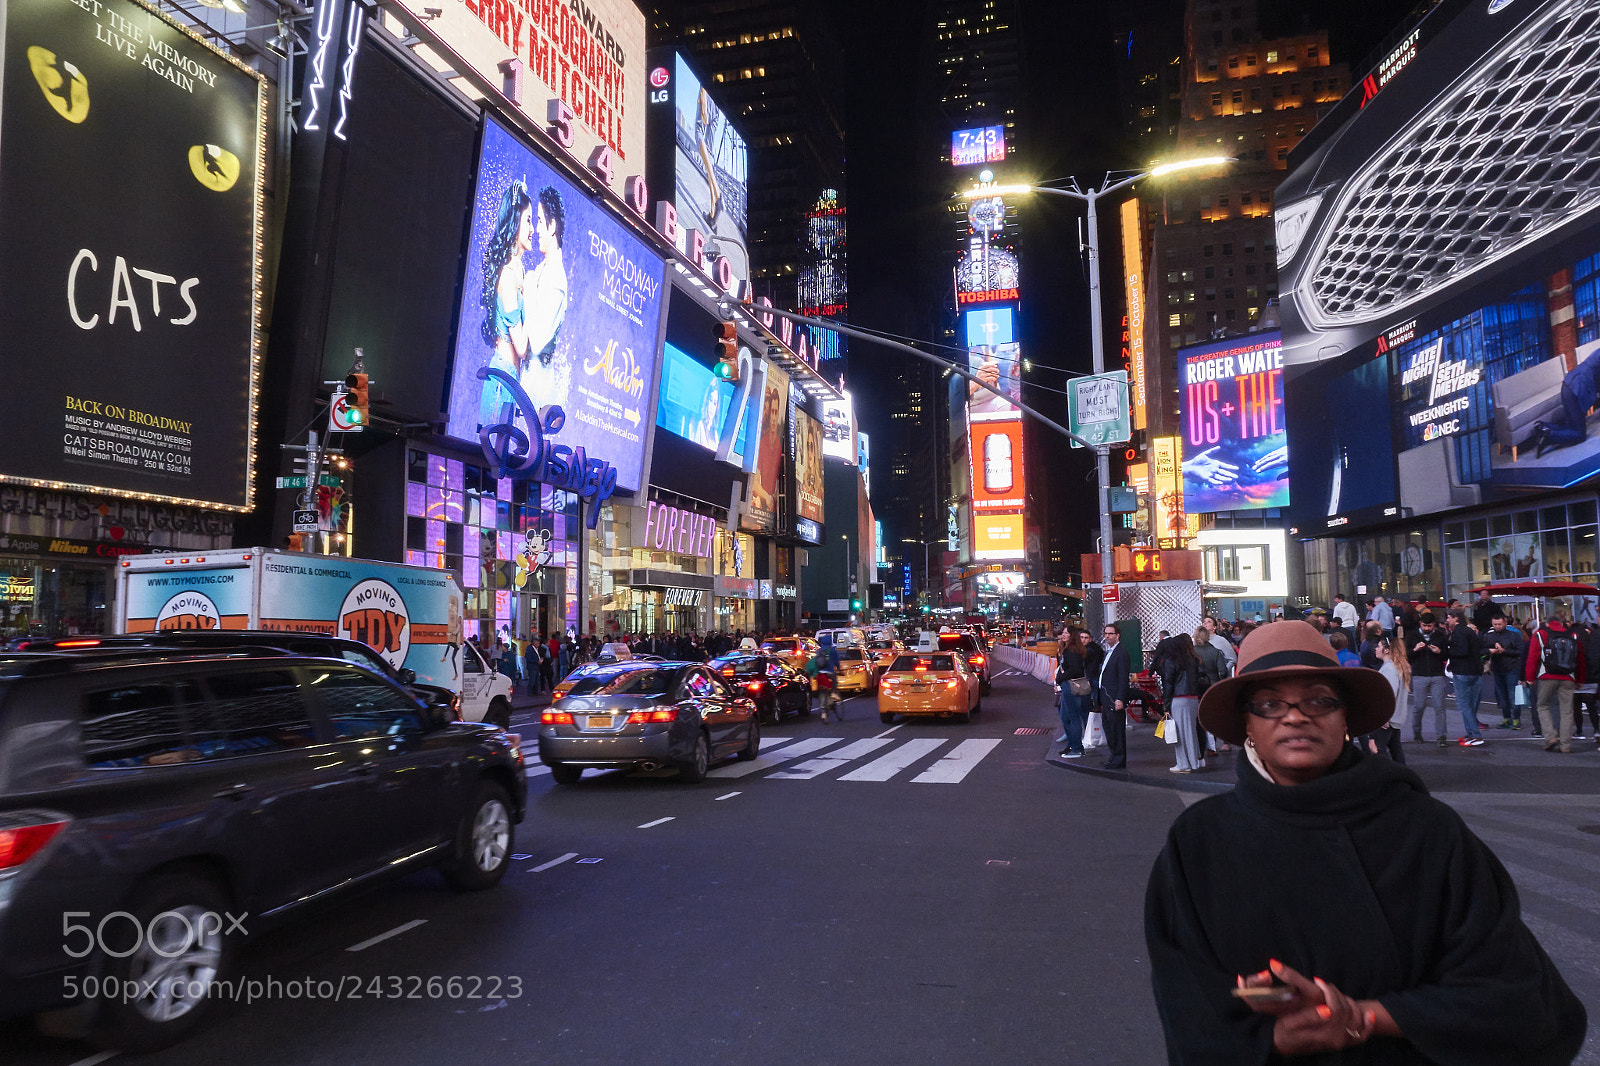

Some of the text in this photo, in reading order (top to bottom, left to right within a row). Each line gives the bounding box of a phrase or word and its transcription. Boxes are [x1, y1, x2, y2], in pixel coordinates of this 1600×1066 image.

[570, 0, 625, 68] AWARD
[96, 23, 194, 94] LIVE AGAIN
[108, 9, 143, 44] THE
[148, 34, 217, 88] MEMORY
[1379, 28, 1420, 74] MARRIOTT
[1380, 47, 1416, 87] MARQUIS
[529, 24, 626, 160] MITCHELL
[651, 89, 668, 104] LG
[959, 130, 996, 148] 7:43
[497, 58, 820, 371] 1540 BROADWAY
[68, 248, 200, 332] CATS
[1130, 274, 1138, 284] 15
[958, 288, 1018, 304] TOSHIBA
[1132, 289, 1142, 328] October
[1388, 320, 1417, 340] MARRIOTT
[1389, 330, 1414, 348] MARQUIS
[1134, 337, 1142, 350] 15
[1200, 350, 1228, 362] CREATIVE
[1230, 346, 1254, 356] GENIUS
[1254, 343, 1264, 351] OF
[1264, 340, 1282, 348] PINK
[1187, 347, 1284, 384] ROGER WATE
[1412, 344, 1437, 368] LATE
[584, 338, 644, 400] Aladdin
[1132, 351, 1146, 406] September
[1402, 360, 1434, 386] NIGHT
[1437, 359, 1467, 384] SETH
[1080, 382, 1115, 394] RIGHT LANE
[1434, 368, 1480, 398] MEYERS
[1086, 396, 1108, 406] MUST
[1188, 380, 1220, 446] US
[1235, 369, 1284, 439] THE
[1410, 396, 1470, 426] WEEKNIGHTS
[66, 396, 192, 434] BACK ON BROADWAY
[1078, 408, 1118, 420] TURN RIGHT
[65, 414, 192, 446] MUSIC BY ANDREW LLOYD WEBBER
[575, 409, 638, 442] AladdinTheMusical.com
[1090, 432, 1104, 441] 45
[1109, 430, 1120, 440] ST
[1438, 419, 1460, 436] NBC
[64, 434, 191, 466] CATSBROADWAY.COM
[72, 447, 86, 457] Neil
[88, 450, 110, 460] Simon
[112, 454, 138, 466] Theatre
[144, 460, 156, 469] 250
[166, 464, 182, 473] 52nd
[1157, 458, 1171, 466] LION
[1157, 466, 1174, 476] KING
[292, 478, 300, 486] 46
[644, 501, 716, 558] FOREVER
[11, 540, 40, 551] Apple
[48, 540, 88, 554] Nikon
[96, 544, 142, 557] Canon
[266, 564, 352, 579] RESIDENTIAL & COMMERCIAL
[1152, 554, 1160, 571] 6
[148, 575, 234, 586] WWW.TDYMOVING.COM
[397, 577, 411, 585] LOCAL
[415, 578, 426, 586] LONG
[426, 580, 446, 588] DISTANCE
[172, 598, 208, 612] MOVING
[356, 588, 397, 608] MOVING
[664, 588, 702, 606] FOREVER 21
[343, 608, 406, 654] TDY
